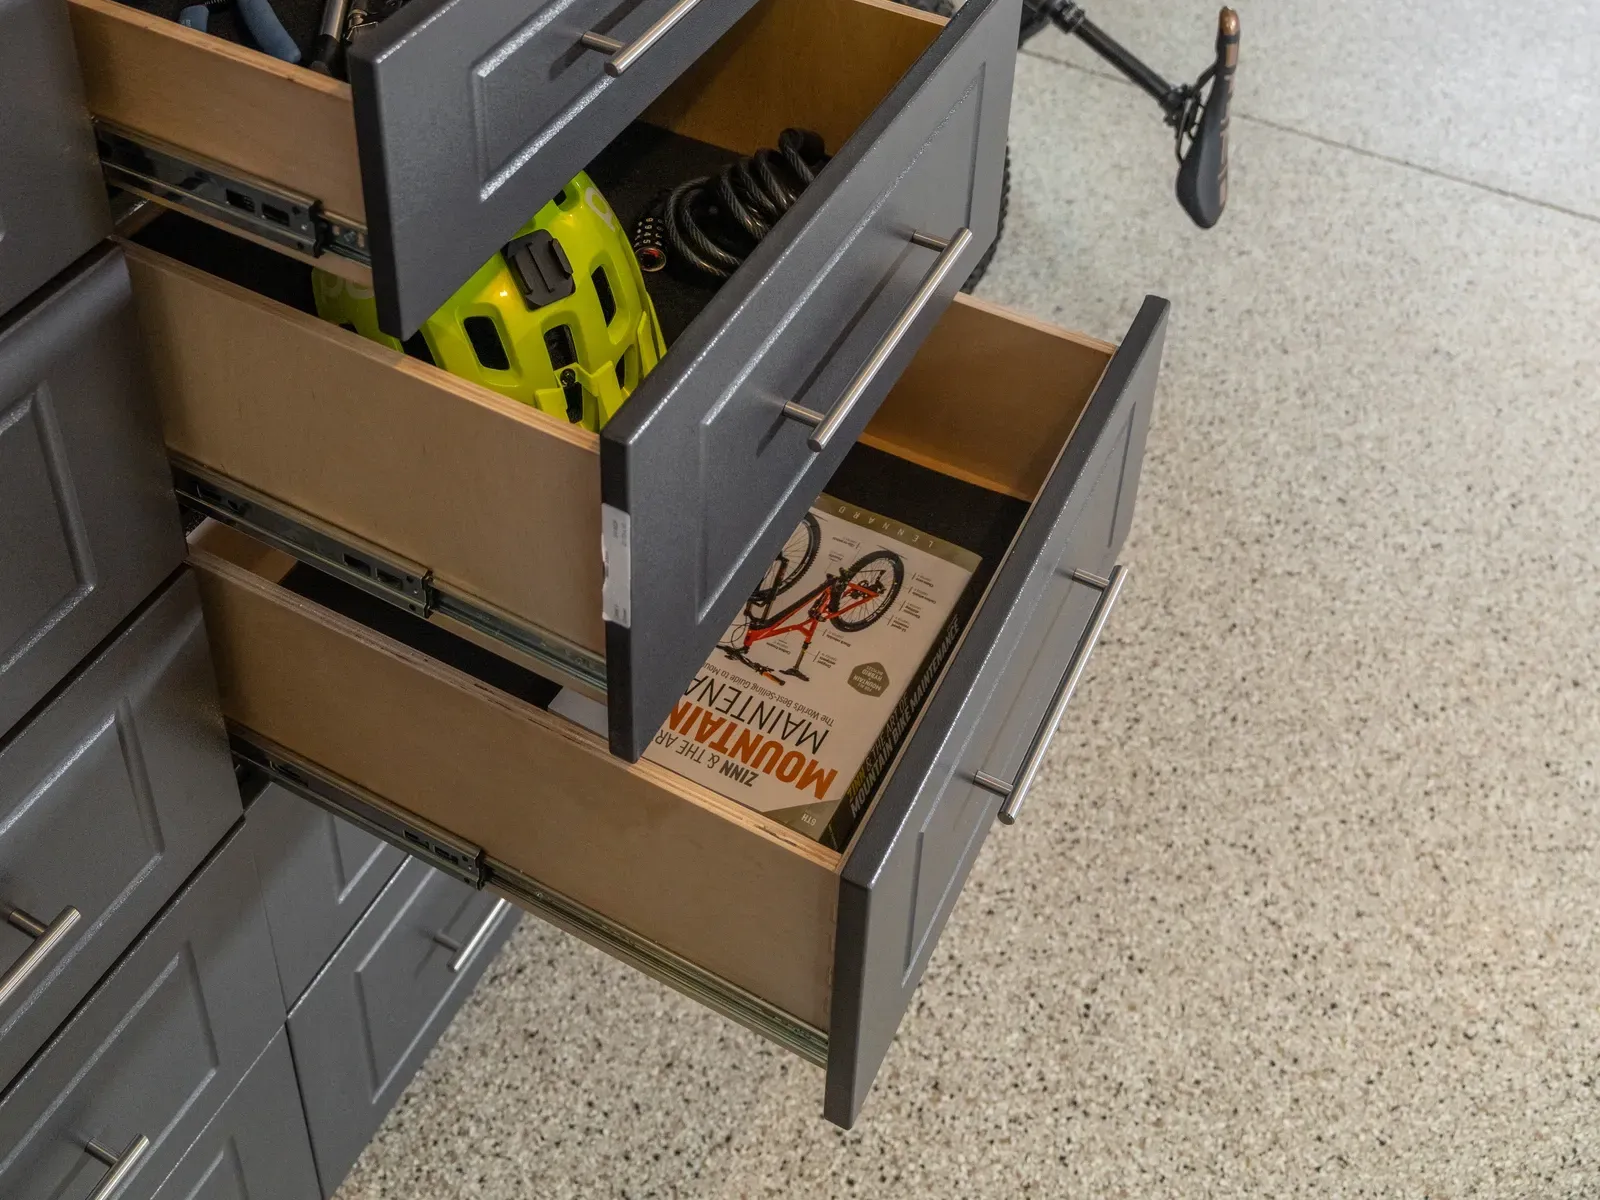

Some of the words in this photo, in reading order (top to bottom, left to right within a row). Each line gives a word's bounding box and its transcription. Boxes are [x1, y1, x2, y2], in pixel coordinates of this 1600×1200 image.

[837, 505, 934, 548] LENNARD
[721, 670, 730, 679] to
[729, 675, 750, 689] Guide
[853, 674, 882, 691] MOUNTAIN
[861, 668, 883, 681] HYBRID
[750, 683, 794, 707] Best-Selling
[682, 675, 829, 755] MAINTENA
[794, 702, 820, 720] World's
[850, 745, 894, 819] MOUNTAIN
[891, 710, 912, 746] BIKE
[910, 615, 960, 712] MAINTENANCE
[820, 715, 835, 727] The
[653, 729, 679, 749] AR
[669, 701, 838, 800] MOUNTAIN
[675, 739, 706, 764] THE
[707, 755, 720, 769] &
[720, 759, 759, 787] ZINN
[801, 812, 817, 826] 6TH
